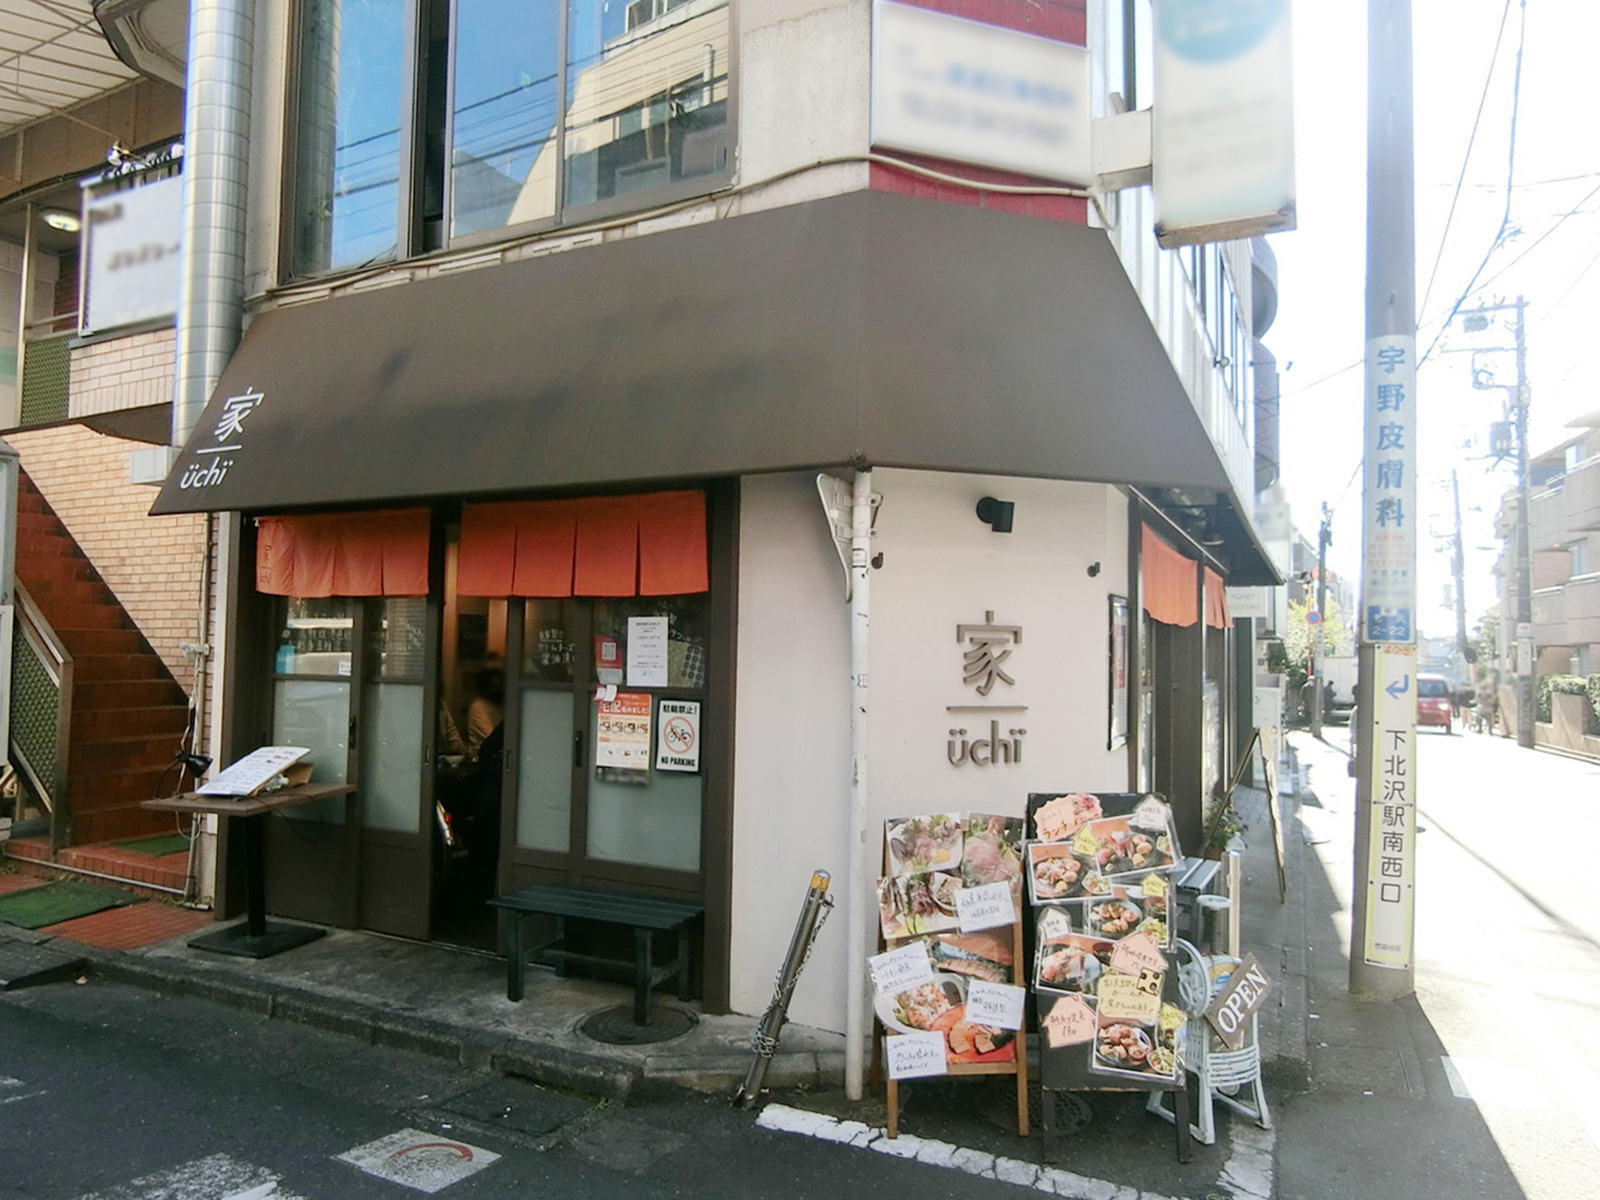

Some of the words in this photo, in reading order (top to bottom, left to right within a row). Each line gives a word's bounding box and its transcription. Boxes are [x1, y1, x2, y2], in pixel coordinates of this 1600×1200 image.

[214, 386, 264, 442] 家
[1375, 345, 1406, 528] 宇野皮膚科
[956, 610, 1022, 697] 家
[1372, 625, 1406, 636] 2-22
[661, 756, 669, 765] NO
[670, 757, 696, 767] PARKING
[1380, 729, 1407, 904] 下北沢駅南西口
[1217, 963, 1268, 1034] OPEN
